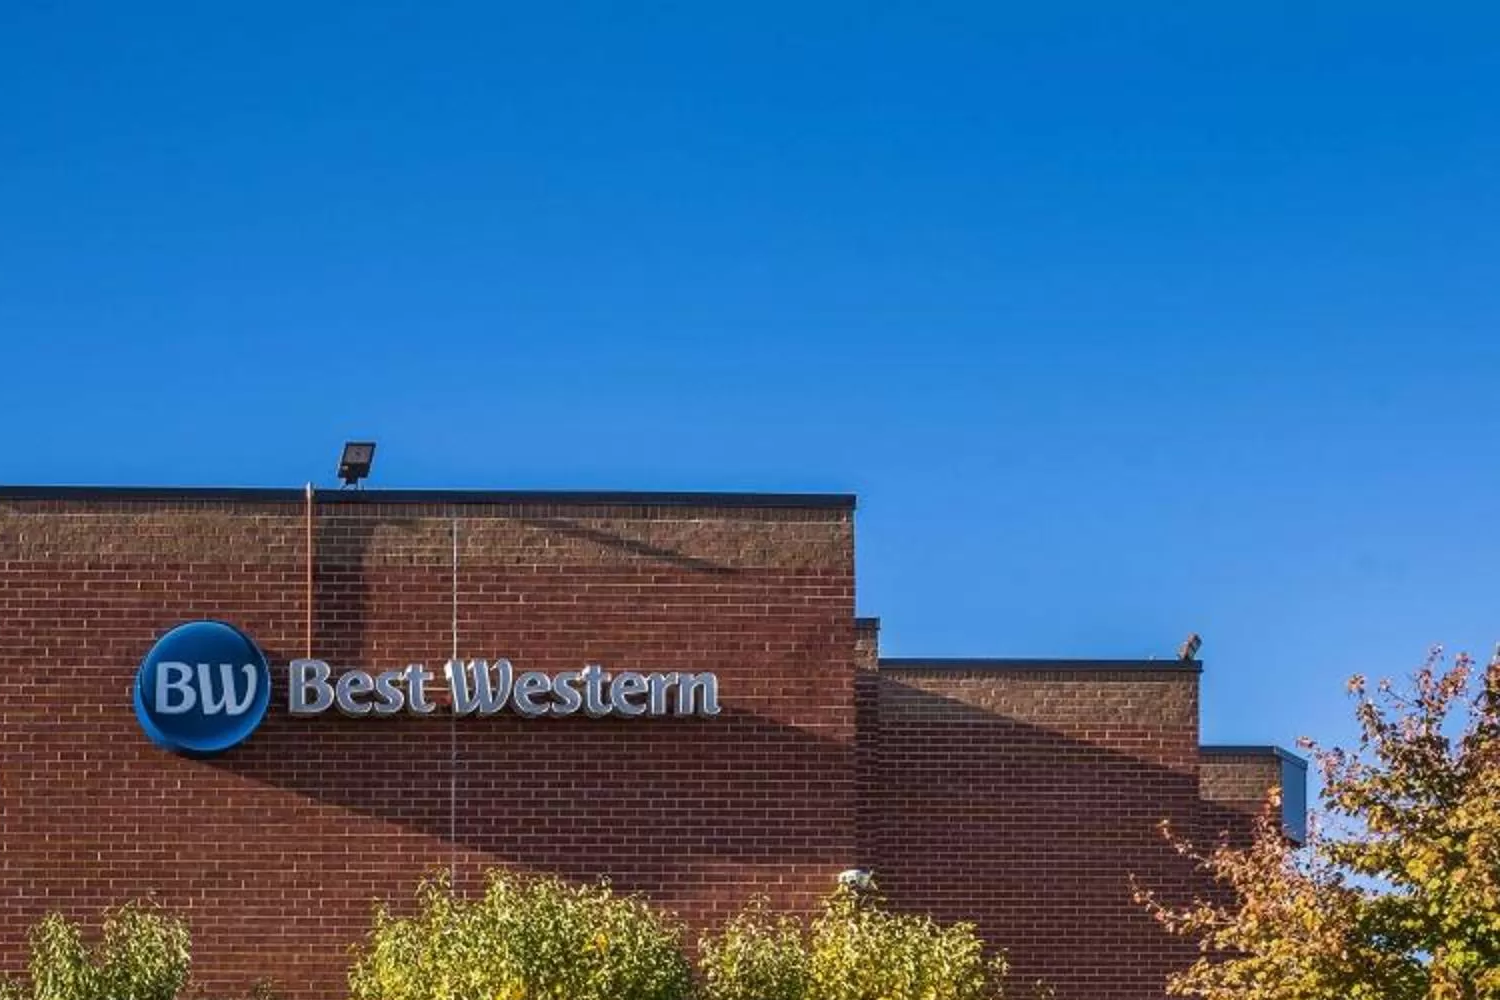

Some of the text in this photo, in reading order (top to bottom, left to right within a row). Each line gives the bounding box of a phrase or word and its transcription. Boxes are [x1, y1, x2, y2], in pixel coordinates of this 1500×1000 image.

[155, 661, 257, 716] BW
[289, 658, 721, 716] Best Western
